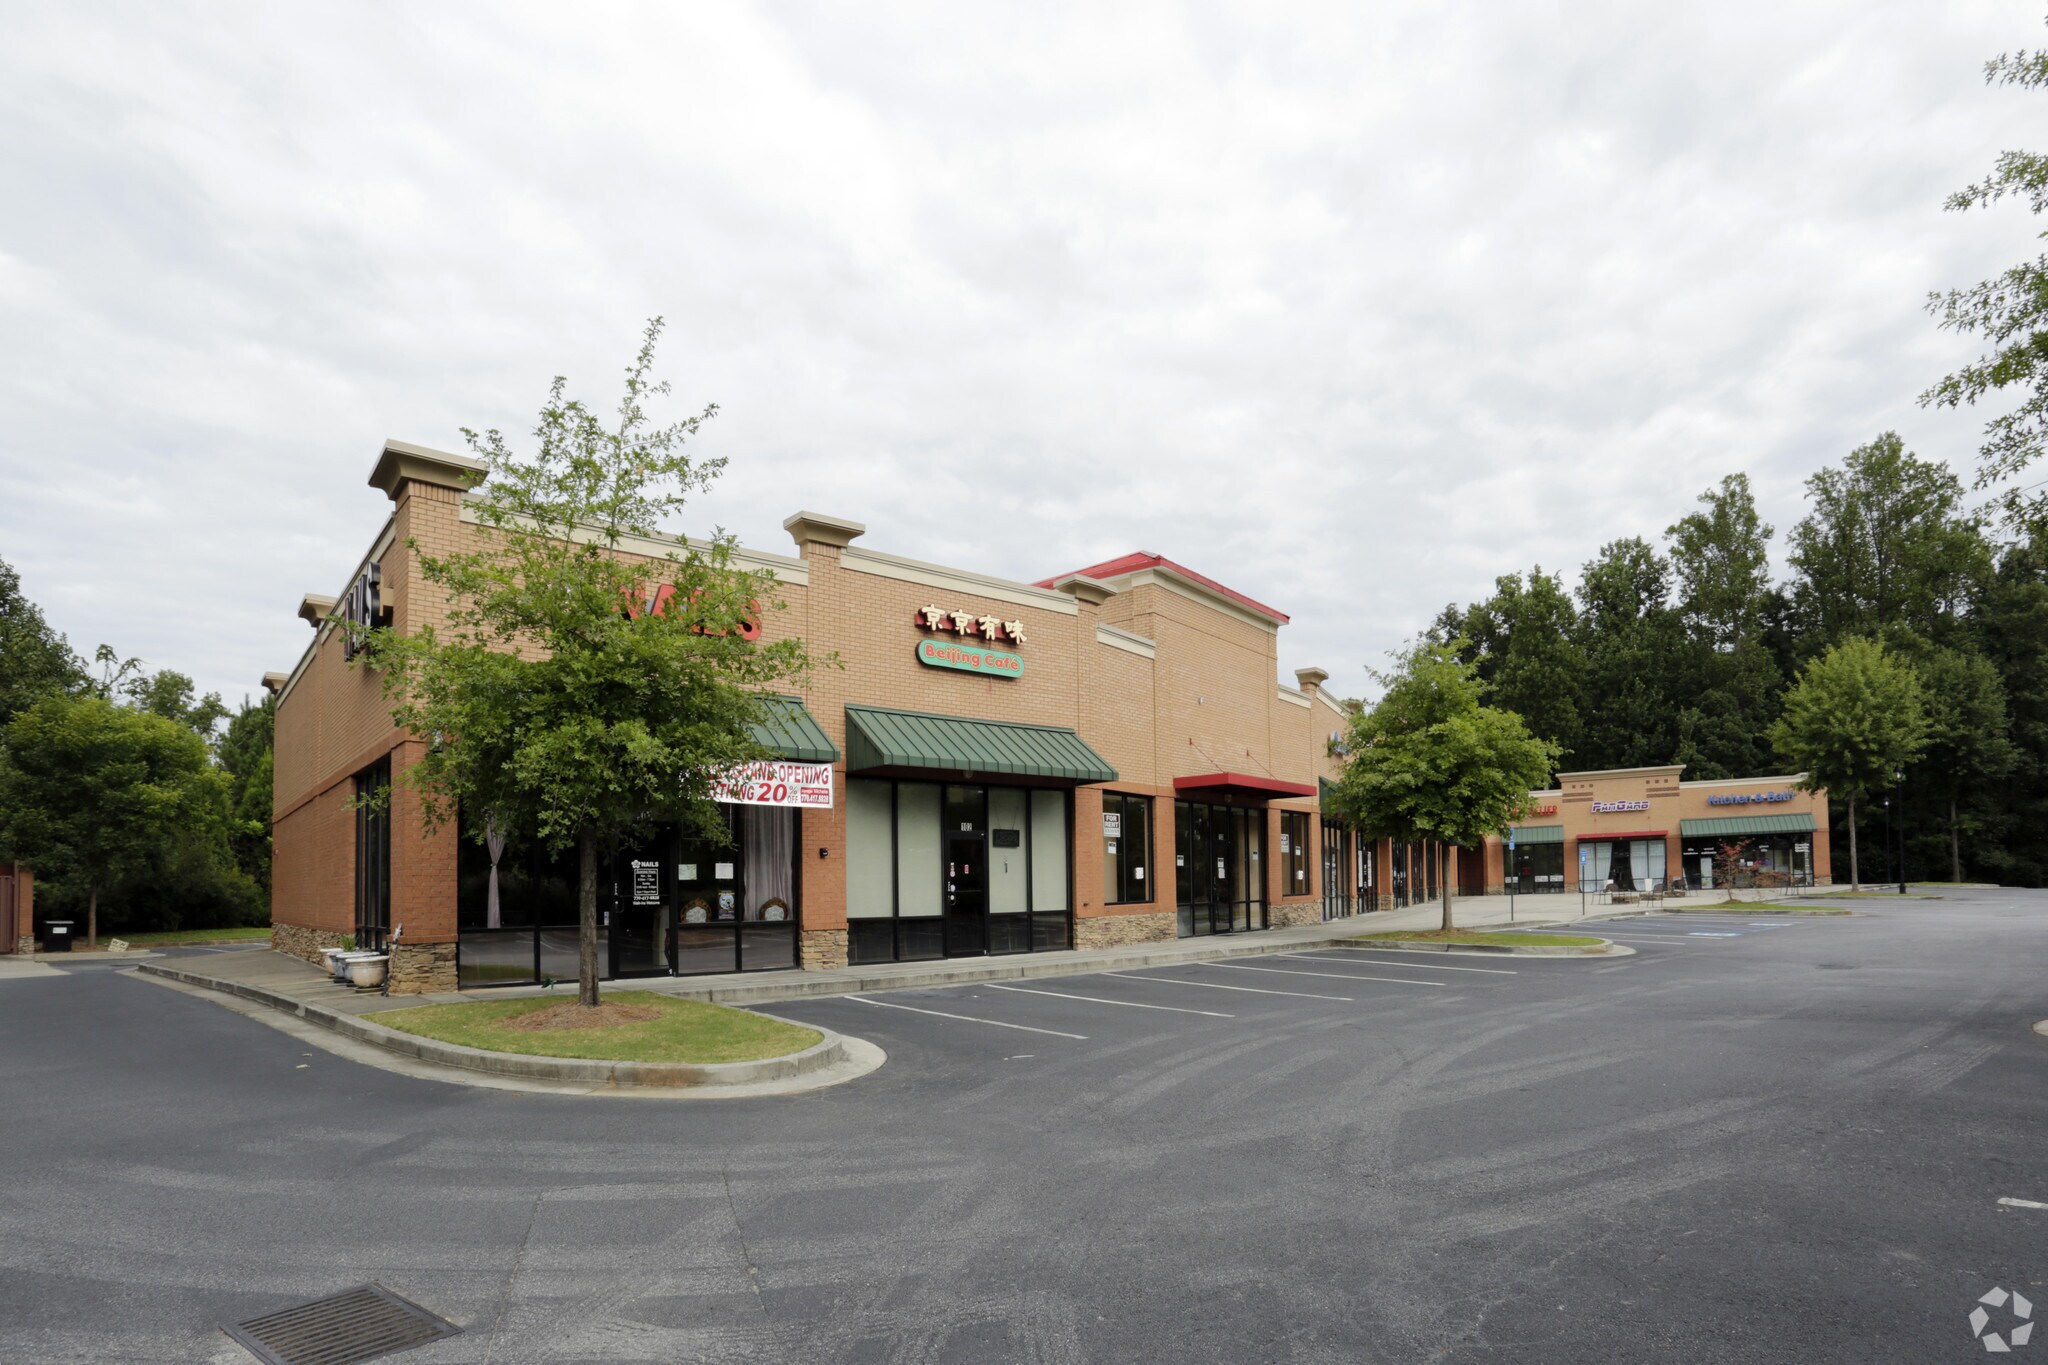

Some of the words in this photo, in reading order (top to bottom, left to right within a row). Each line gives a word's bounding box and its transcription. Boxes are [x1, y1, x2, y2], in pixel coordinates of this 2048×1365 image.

[920, 603, 1028, 645] 京京有味
[924, 644, 980, 668] Beijing
[984, 653, 1019, 671] Café
[778, 764, 829, 785] OPENING
[757, 782, 788, 803] 20
[787, 796, 798, 804] OFF
[1707, 793, 1752, 805] Kitchen
